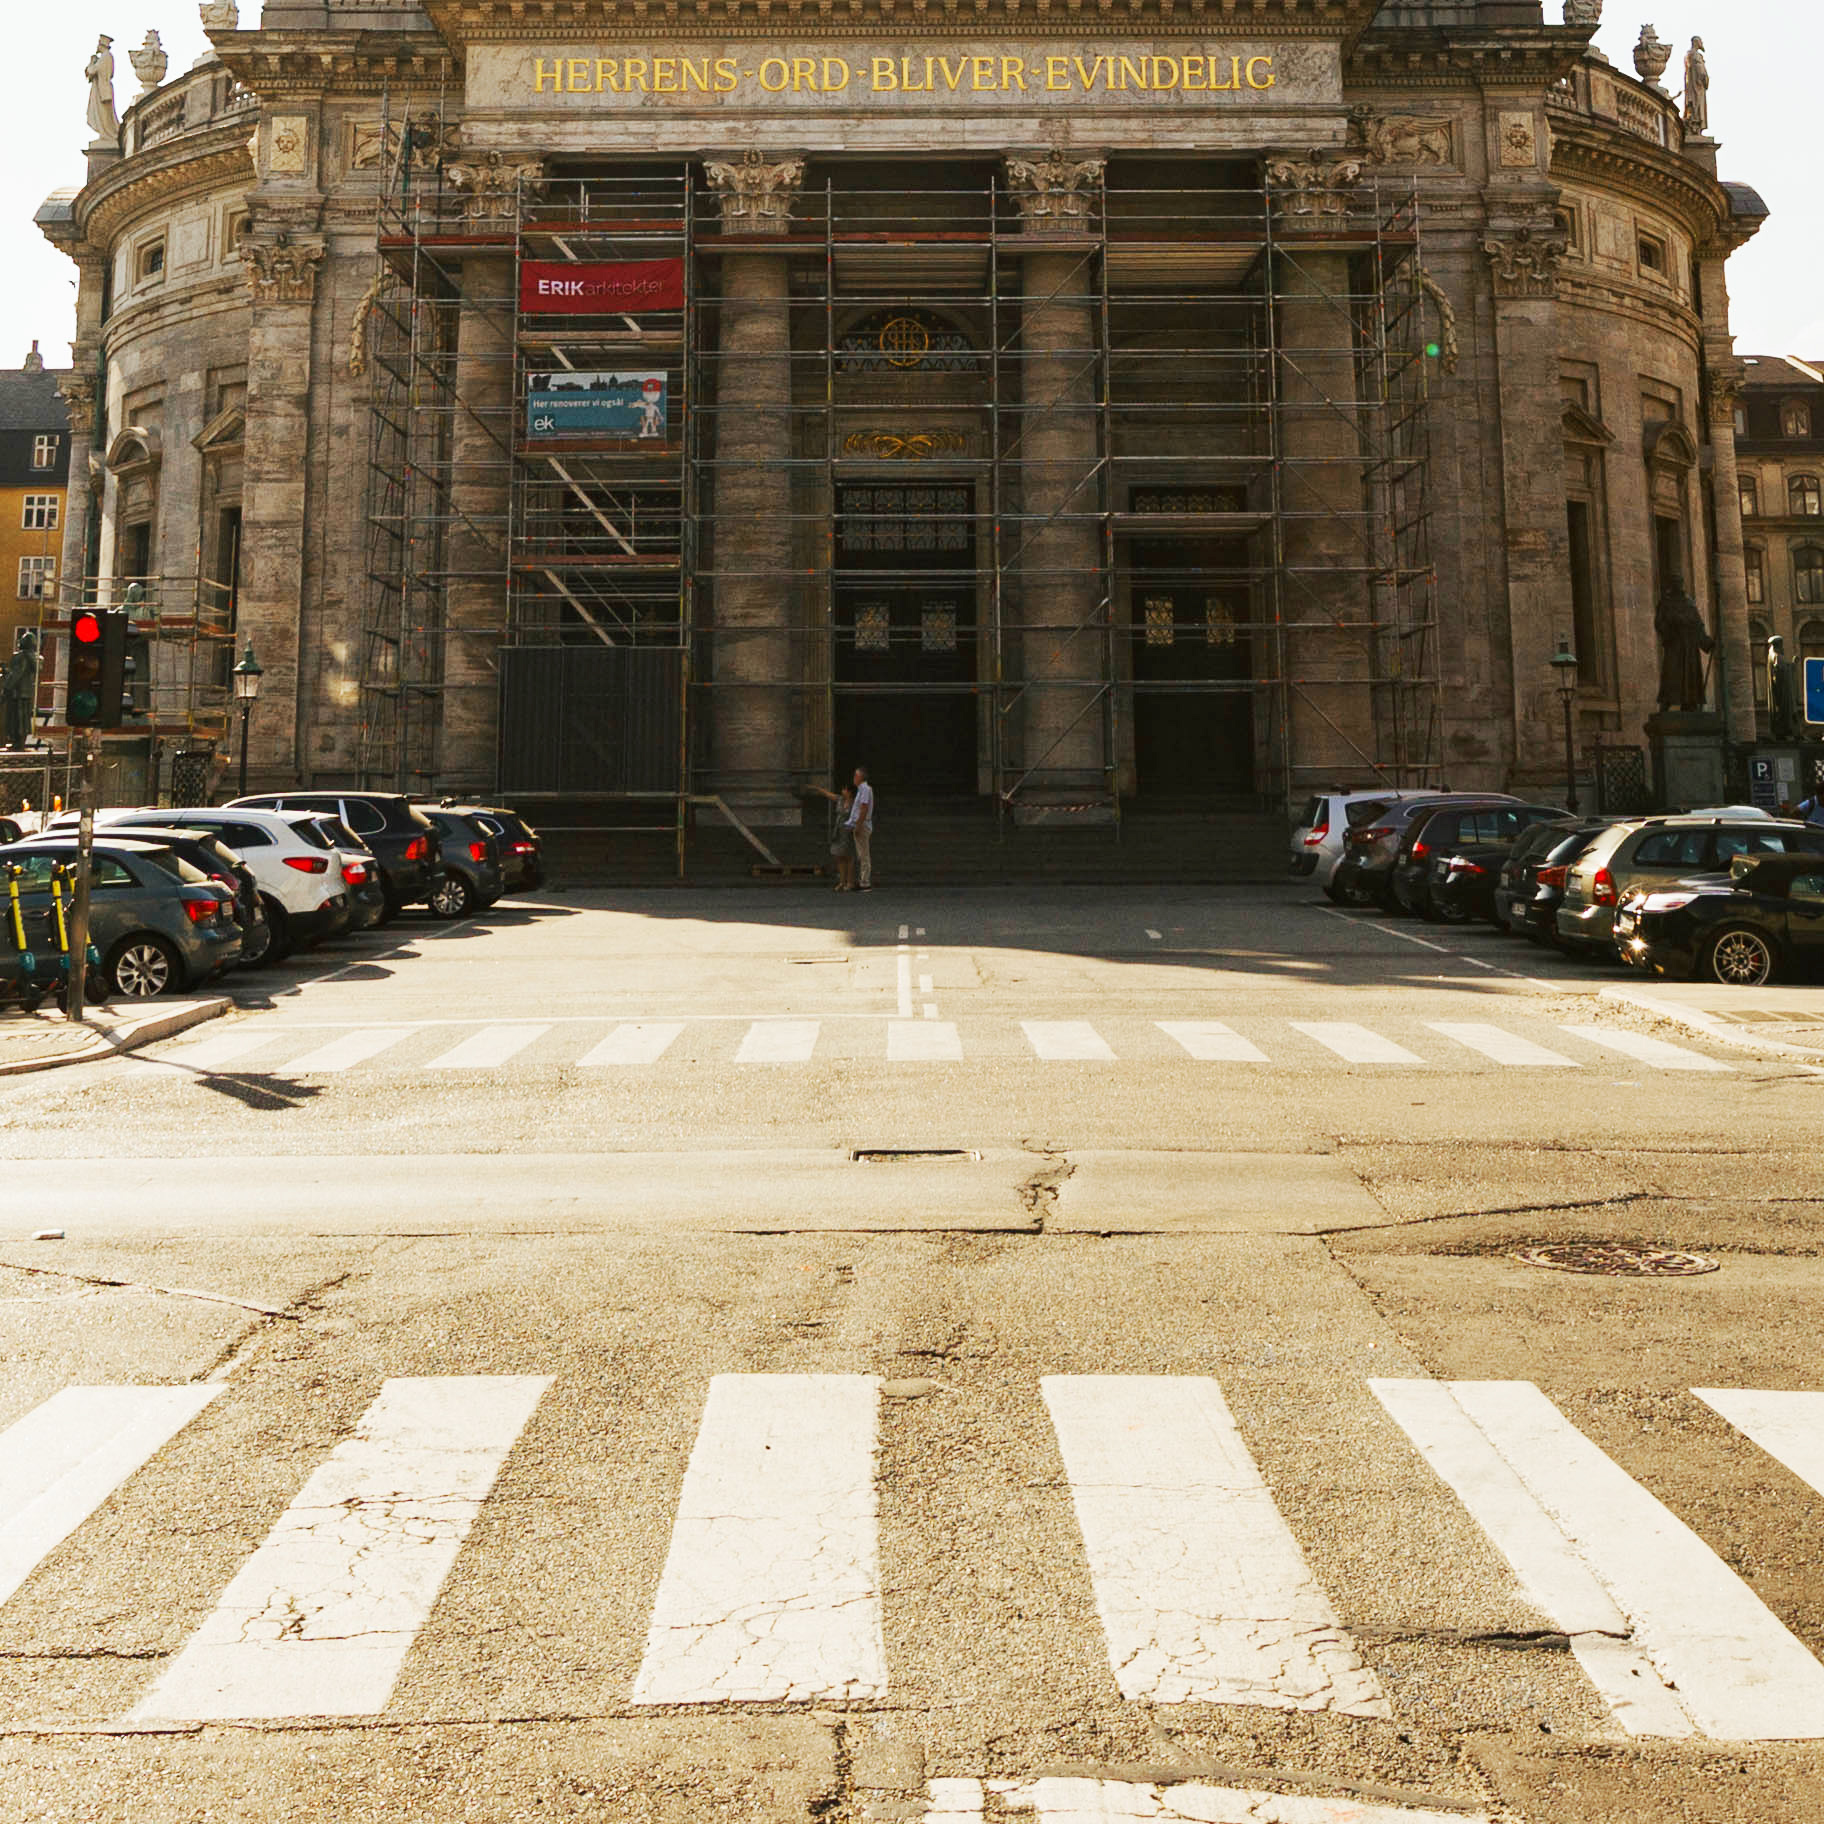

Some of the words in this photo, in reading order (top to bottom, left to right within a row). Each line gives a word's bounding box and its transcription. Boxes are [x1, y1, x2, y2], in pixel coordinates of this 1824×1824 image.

[534, 57, 738, 93] HERRENS
[759, 57, 850, 92] ORD
[871, 56, 1028, 92] BLIVER
[1045, 56, 1276, 91] EVINDELIG
[534, 415, 554, 431] ek
[1756, 762, 1768, 777] P
